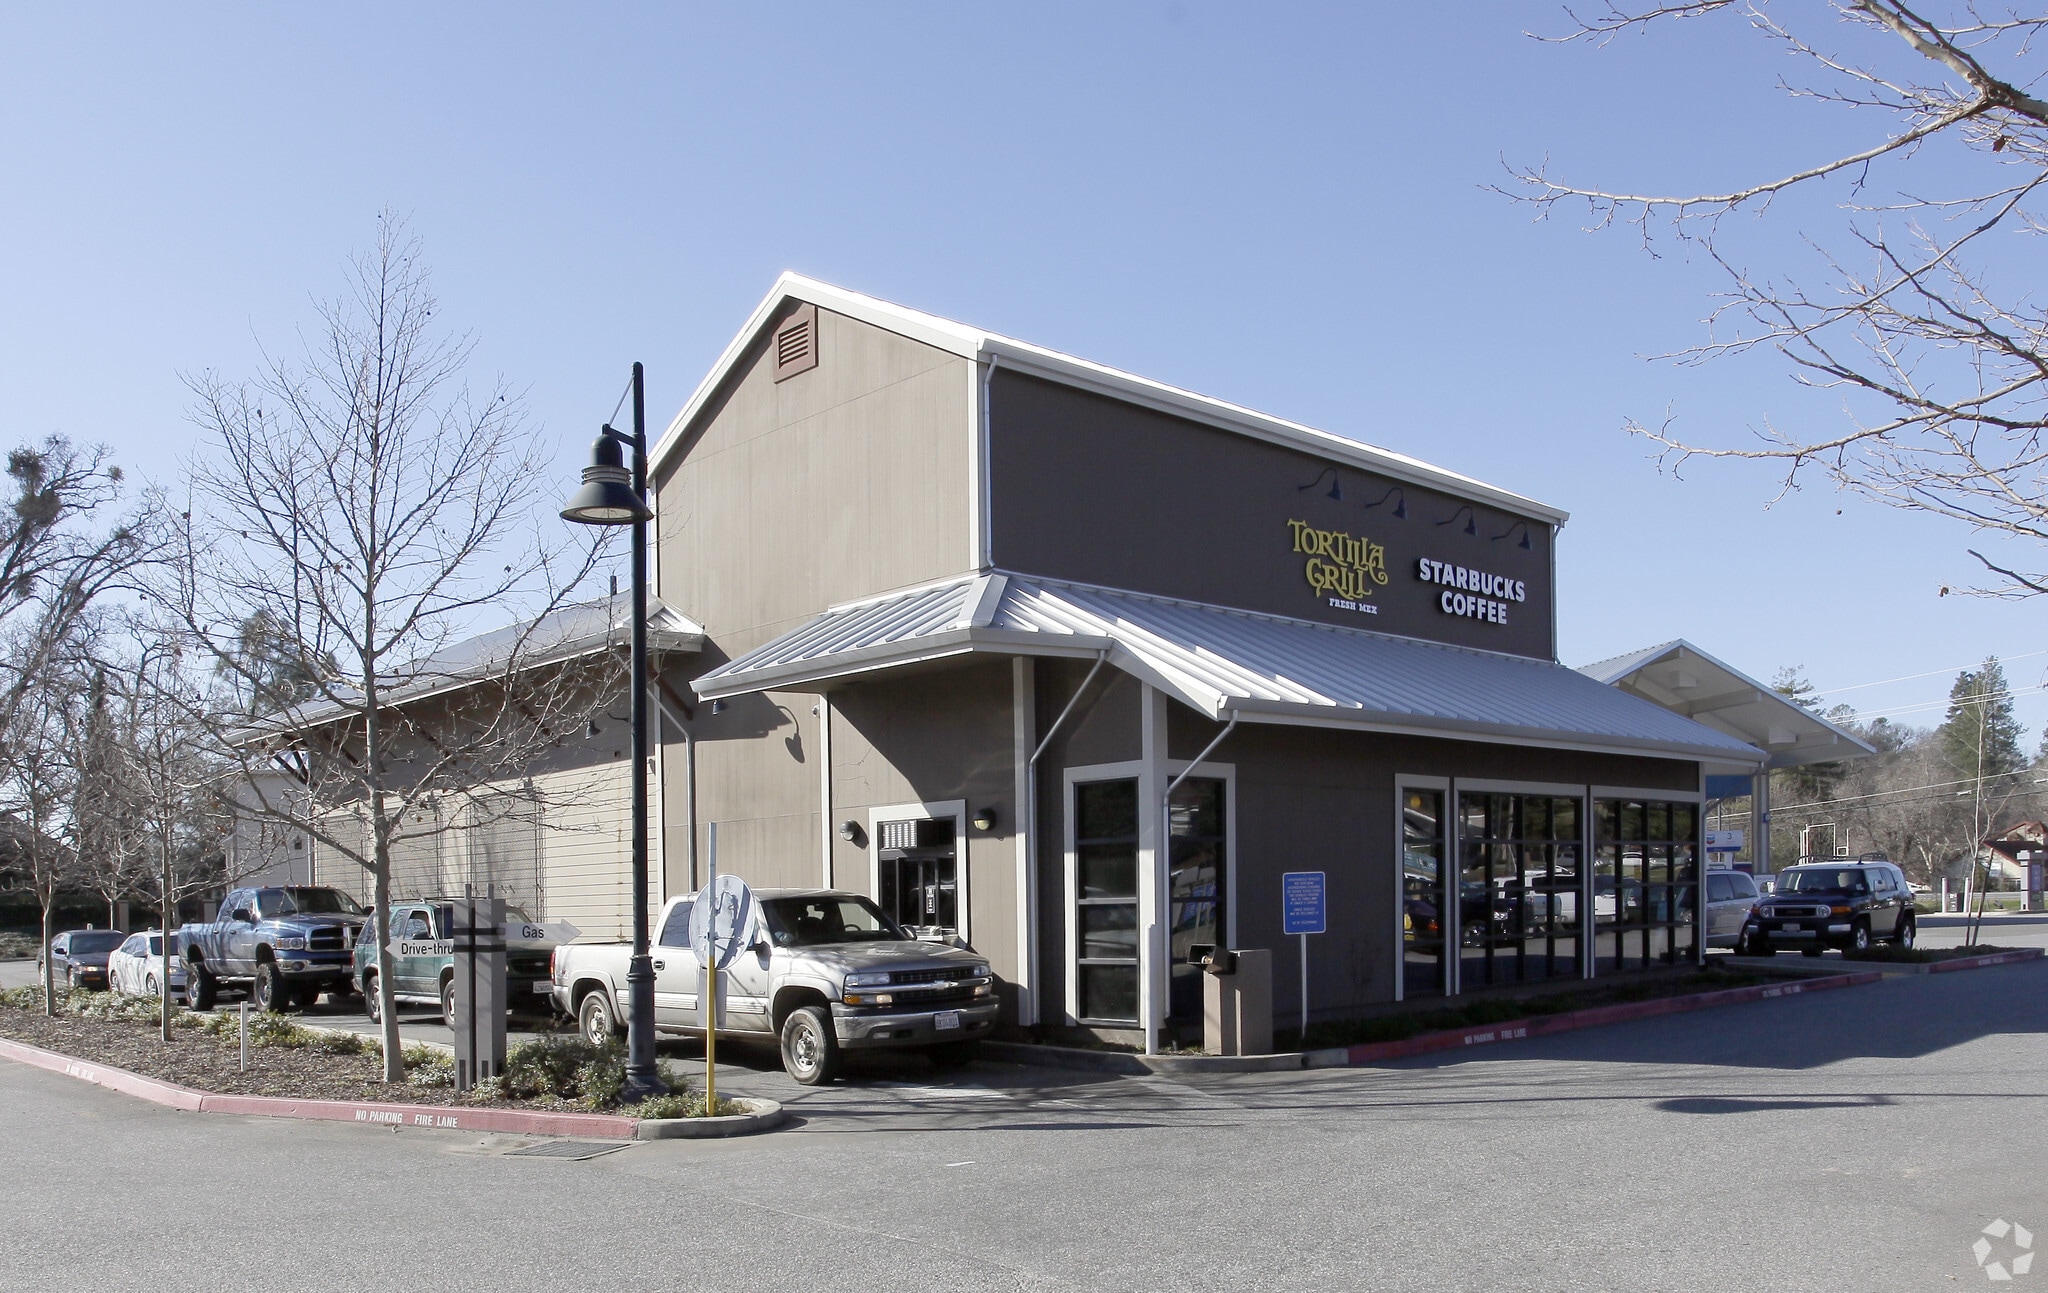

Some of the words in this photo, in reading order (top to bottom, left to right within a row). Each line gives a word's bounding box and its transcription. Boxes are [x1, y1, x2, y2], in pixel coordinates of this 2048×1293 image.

[1287, 518, 1389, 585] TORTILLA
[1305, 557, 1372, 600] GRILL
[1419, 557, 1526, 602] STARBUCKS
[1329, 597, 1357, 611] FRESH
[1358, 603, 1378, 615] MEX
[1441, 591, 1508, 625] COFFEE
[1727, 832, 1733, 840] 3
[521, 925, 545, 939] Gas
[401, 942, 454, 955] Drive-thru
[1473, 1032, 1496, 1044] PARKING
[1501, 1029, 1513, 1040] FIRE
[1514, 1027, 1527, 1038] LANE
[355, 1109, 367, 1121] NO
[369, 1110, 403, 1124] PARKING
[414, 1114, 434, 1126] FIRE
[436, 1115, 458, 1128] LANE
